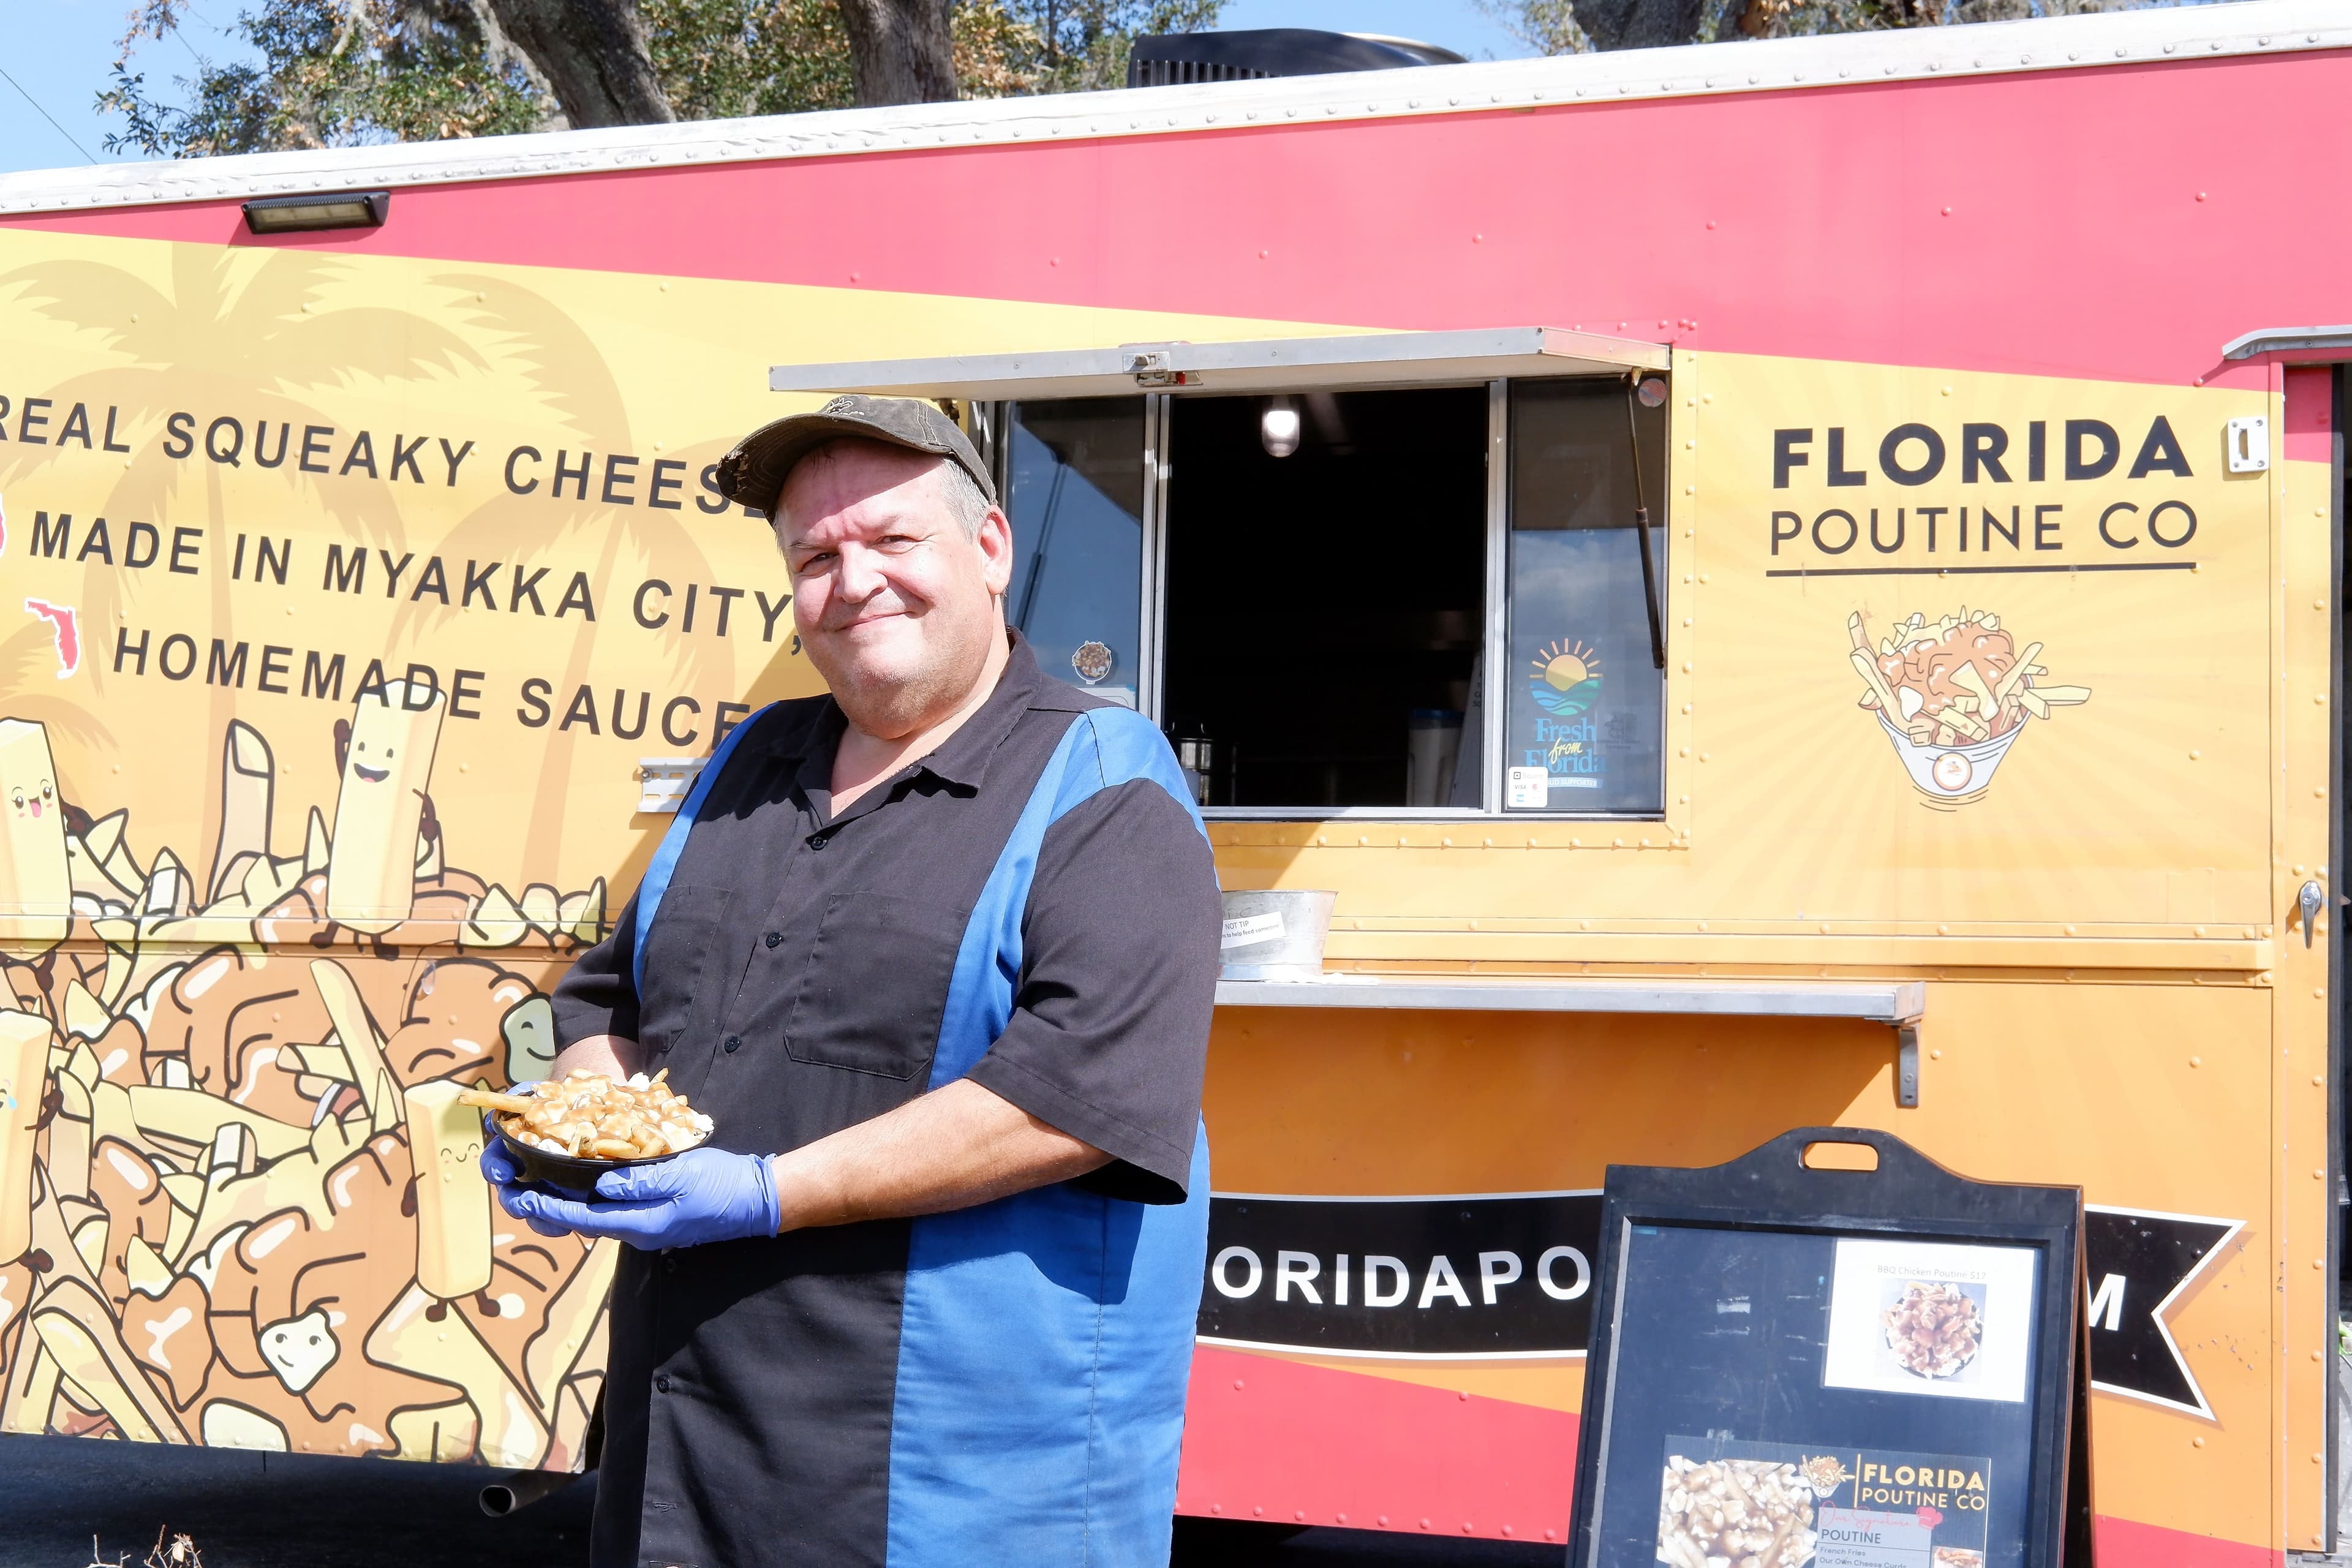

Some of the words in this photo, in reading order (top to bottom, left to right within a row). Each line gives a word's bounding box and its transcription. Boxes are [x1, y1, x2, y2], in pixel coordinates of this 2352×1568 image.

[1773, 415, 2195, 489] FLORIDA
[163, 412, 475, 488] SQUEAKY
[504, 445, 765, 519] CHEES
[1771, 504, 2064, 556] POUTINE
[2098, 500, 2198, 549] CO
[30, 511, 205, 575] MADE
[232, 533, 292, 586] IN
[323, 544, 597, 622] MYAKKA
[633, 579, 802, 656] CITY,
[113, 627, 486, 720] HOMEMADE
[1535, 717, 1597, 742] Fresh
[1524, 748, 1607, 774] Florida
[1548, 737, 1583, 764] from
[1877, 1265, 1896, 1275] BBQ
[1898, 1267, 1931, 1276] Chicken
[1934, 1268, 1967, 1278] Poutine
[1970, 1271, 1986, 1280] $17
[1863, 1463, 1985, 1491] FLORIDA
[1861, 1487, 1948, 1509] POUTINE
[1956, 1494, 1986, 1511] CO
[1821, 1528, 1882, 1544] POUTINE
[1820, 1546, 1846, 1555] French
[1853, 1559, 1882, 1568] Cheese
